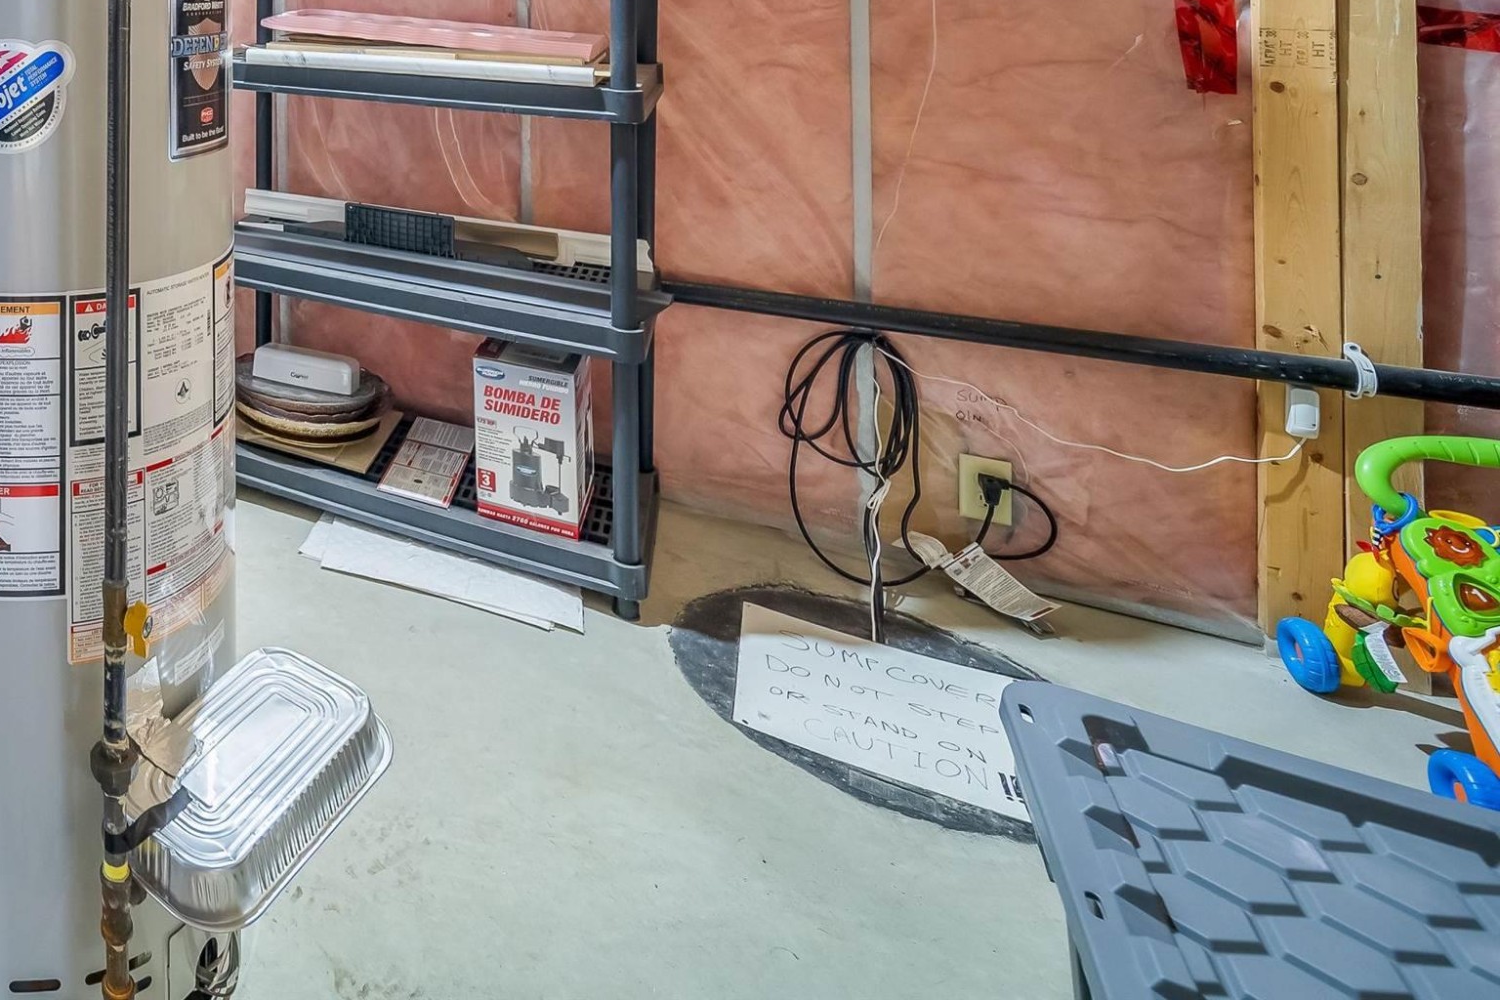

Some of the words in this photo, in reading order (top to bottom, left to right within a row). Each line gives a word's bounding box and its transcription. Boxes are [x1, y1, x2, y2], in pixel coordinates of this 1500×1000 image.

[182, 2, 211, 12] BRADFORD
[172, 33, 228, 57] DEFENDE
[1312, 41, 1325, 57] HT
[183, 60, 205, 72] SAFETY
[528, 376, 569, 388] SUMERGIBLE
[483, 385, 536, 407] BOMBA
[540, 396, 562, 411] DE
[483, 399, 561, 425] SUMIDERO
[481, 474, 491, 487] 3
[779, 629, 880, 673] SUMP
[884, 665, 997, 708] COVER
[765, 653, 812, 678] DO
[823, 673, 894, 701] NOT
[907, 701, 1000, 736] STEP
[768, 685, 812, 705] OR
[822, 703, 918, 740] STAND
[937, 740, 987, 764] ON
[802, 718, 990, 791] CAUTION
